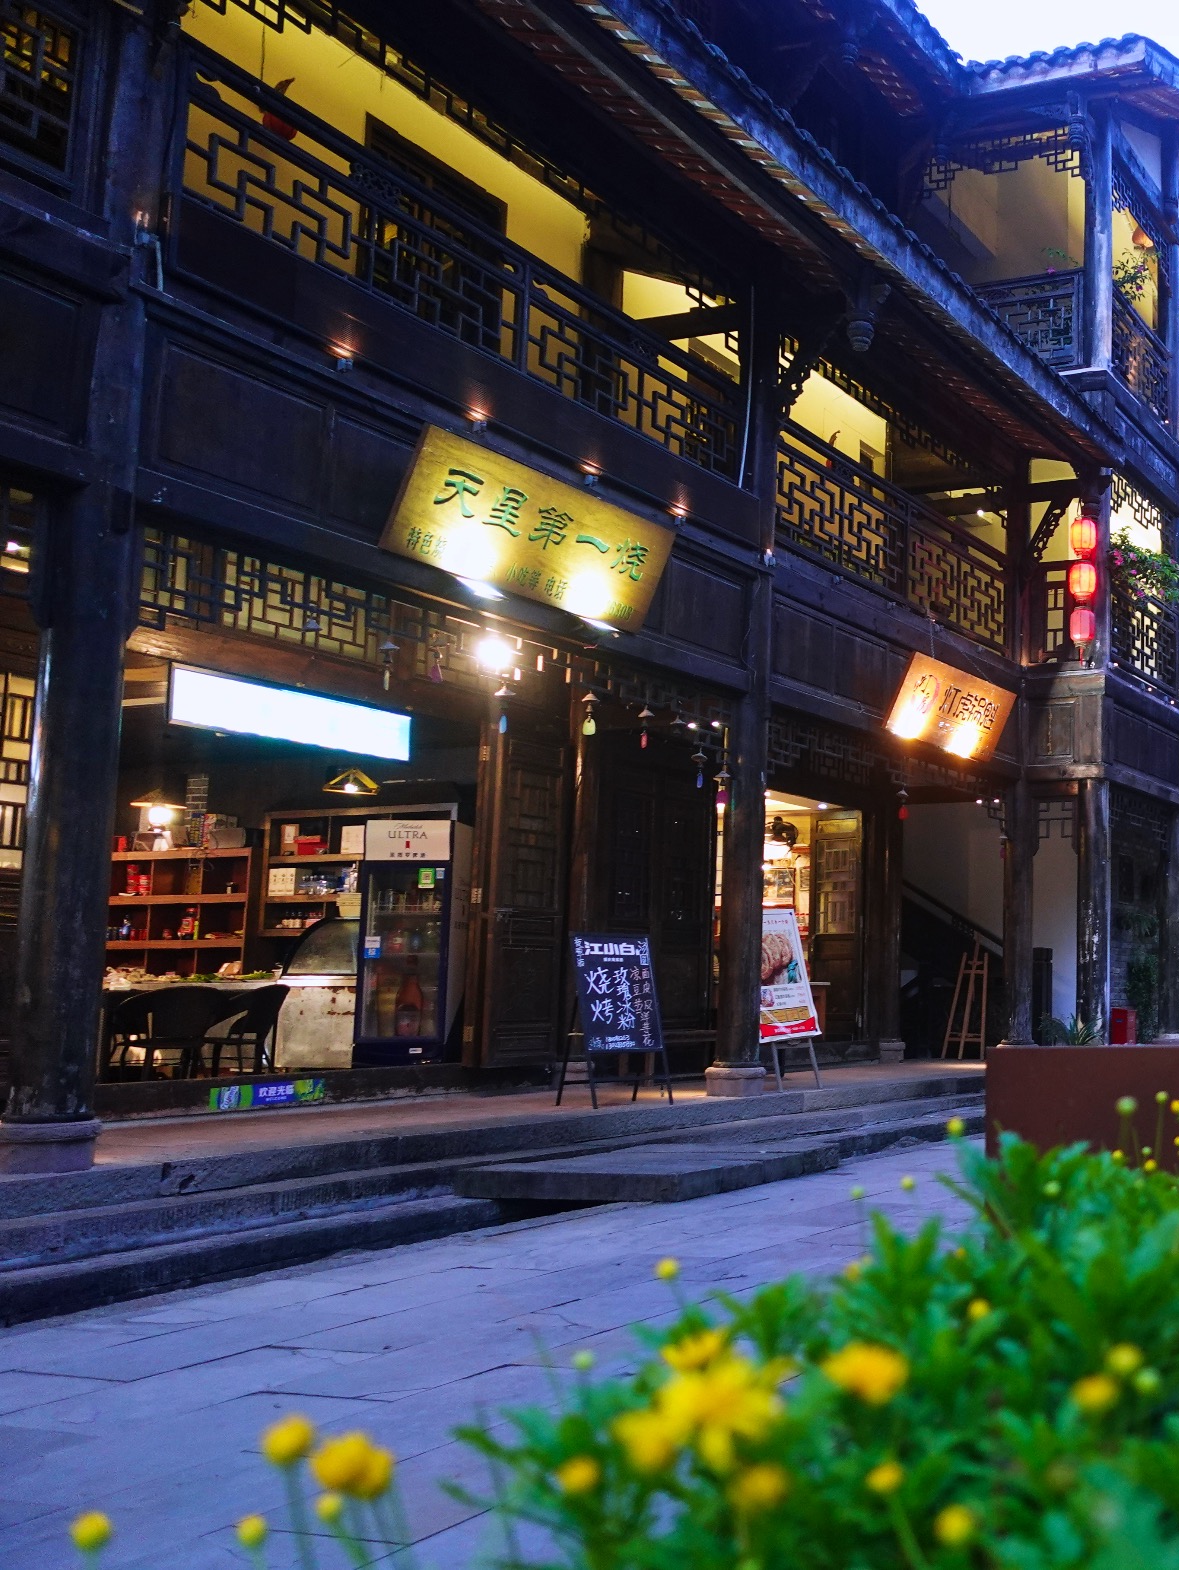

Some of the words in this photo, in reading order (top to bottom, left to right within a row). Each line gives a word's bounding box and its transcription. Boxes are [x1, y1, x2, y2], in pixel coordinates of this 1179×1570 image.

[433, 467, 651, 581] 天星第一烧
[387, 830, 428, 840] ULTRA
[584, 940, 636, 956] 江小白
[583, 966, 615, 1025] 烧烤
[612, 966, 637, 1031] 玫瑰冰粉
[259, 1085, 295, 1097] 欢迎光临
